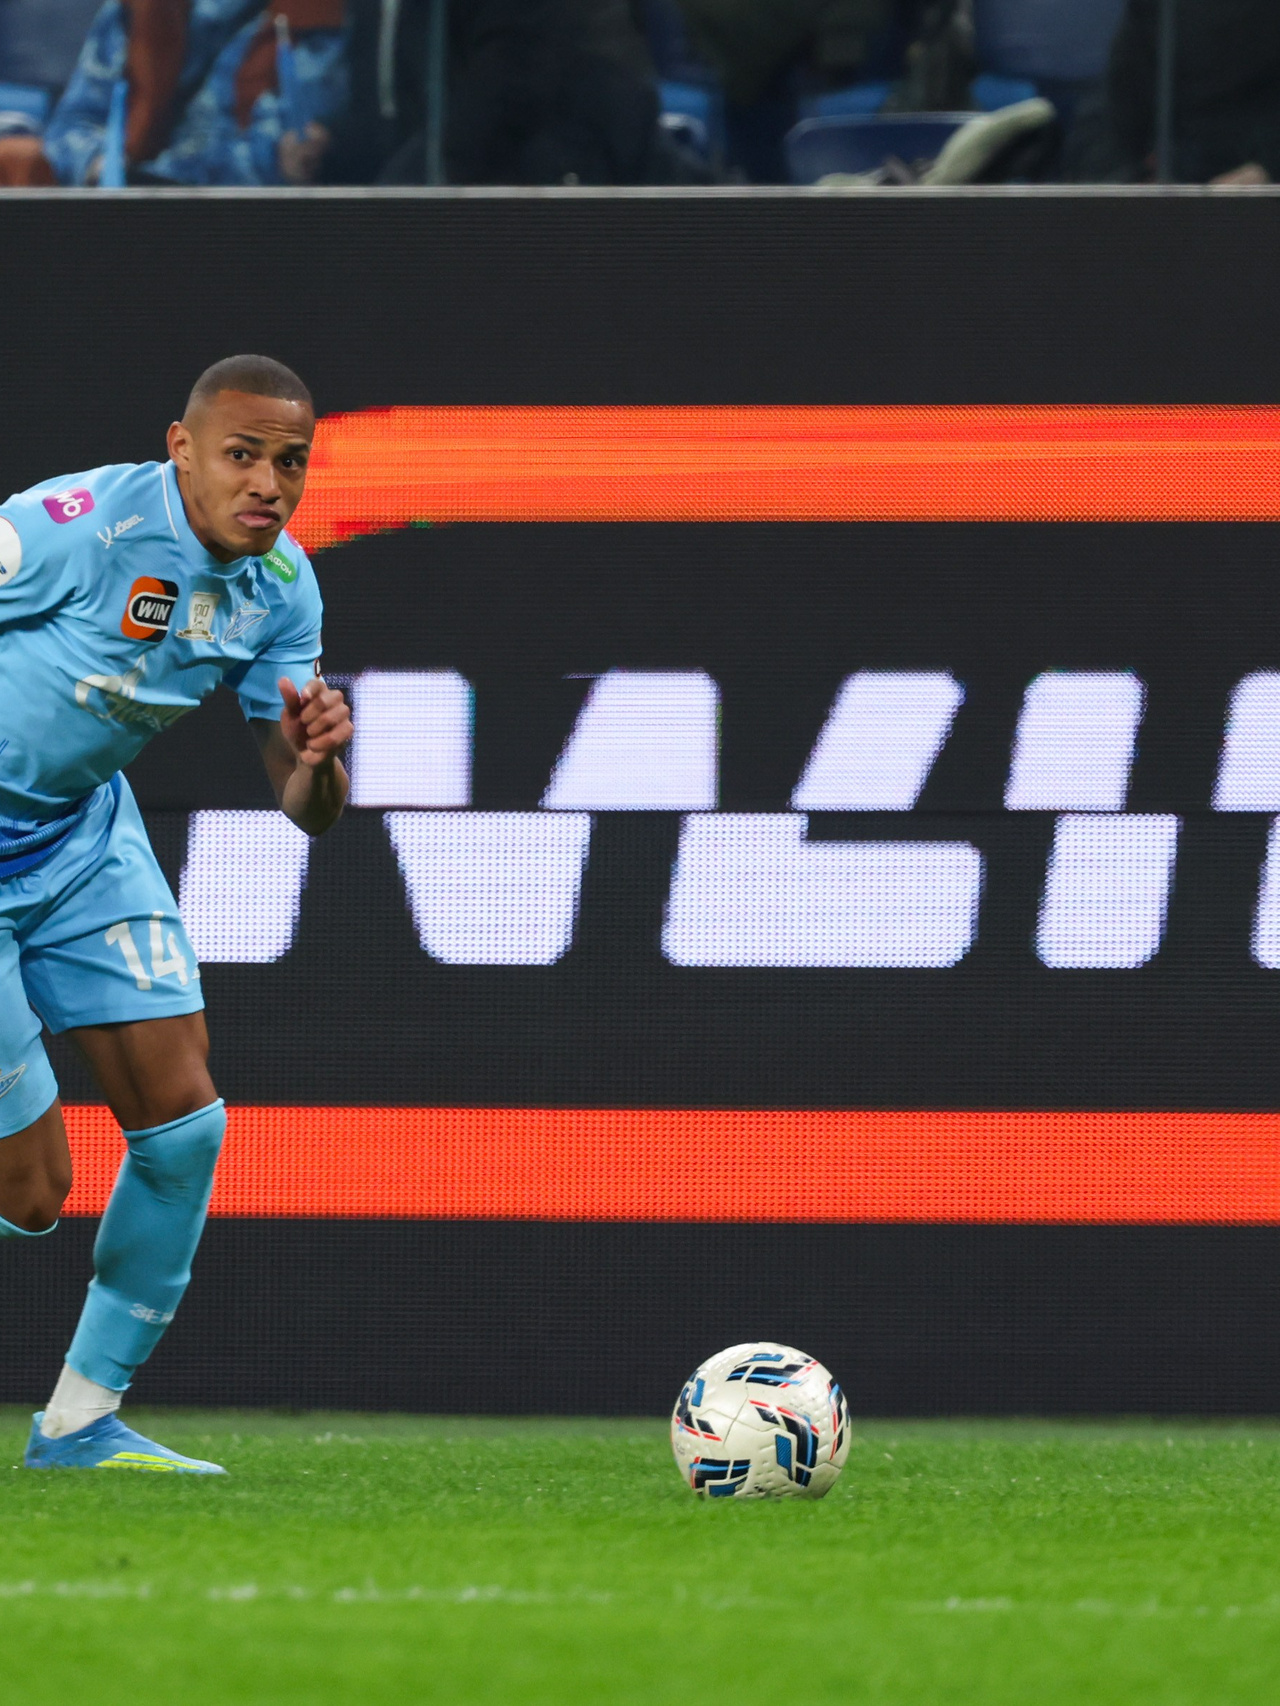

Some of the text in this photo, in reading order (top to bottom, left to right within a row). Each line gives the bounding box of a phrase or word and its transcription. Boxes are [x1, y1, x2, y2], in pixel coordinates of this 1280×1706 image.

[265, 553, 293, 577] АФОН
[137, 600, 170, 621] WIN
[105, 910, 189, 991] 14
